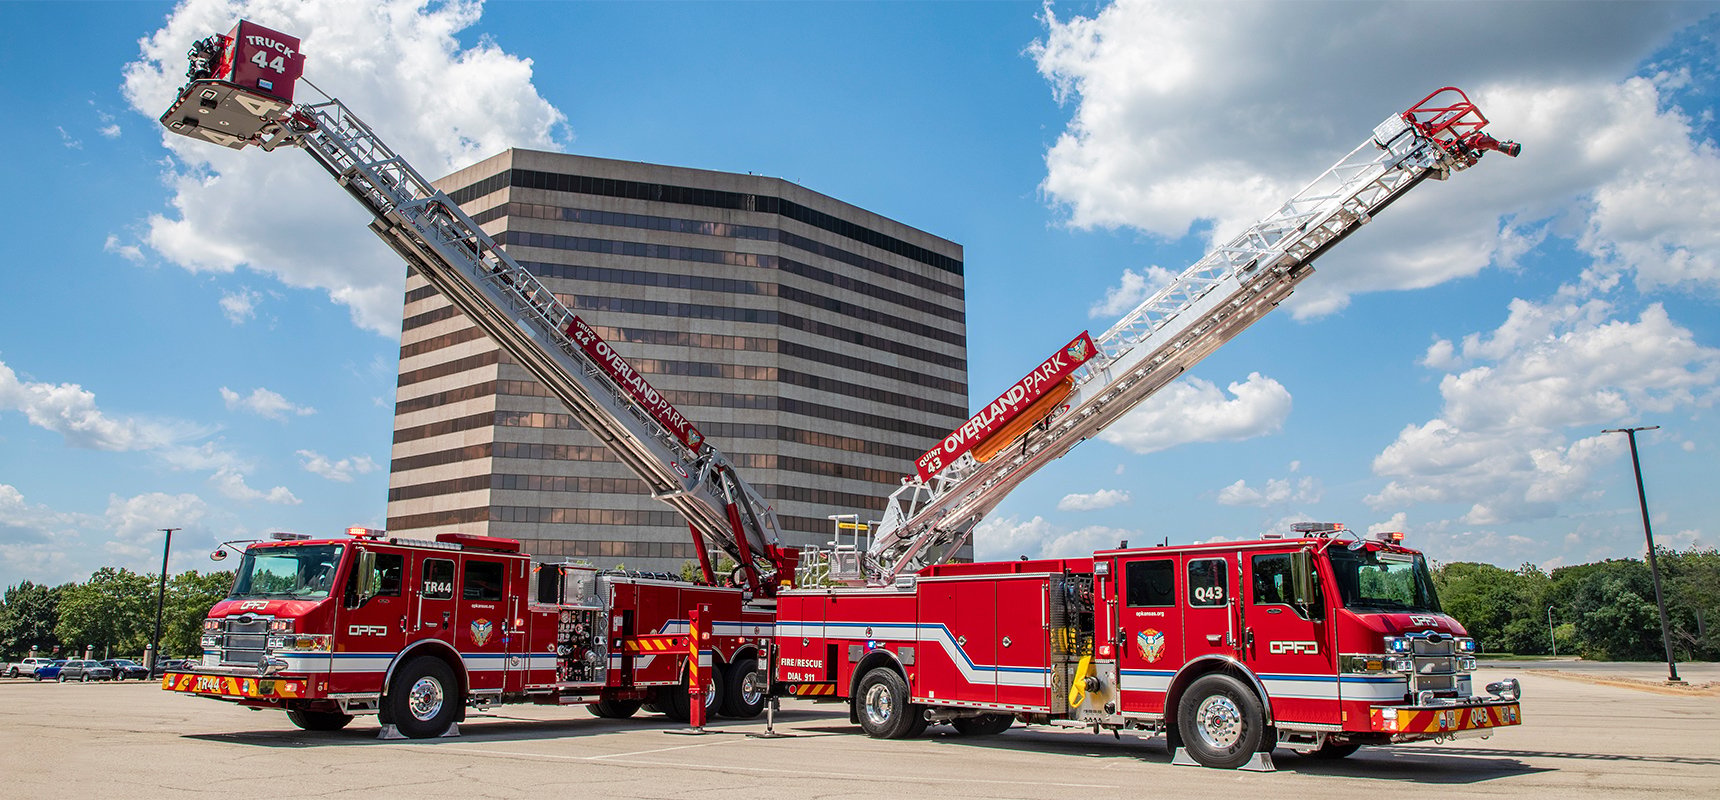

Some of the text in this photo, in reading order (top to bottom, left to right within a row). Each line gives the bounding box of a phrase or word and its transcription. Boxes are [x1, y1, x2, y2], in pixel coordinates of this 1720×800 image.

[246, 35, 295, 59] TRUCK
[251, 50, 286, 74] 44
[574, 331, 590, 347] 44
[576, 320, 597, 342] TRUCK
[596, 341, 689, 434] OVERLAND PARK
[613, 371, 663, 419] KANSAS
[944, 352, 1067, 454] OVERLAND PARK
[975, 388, 1041, 441] KANSAS
[919, 447, 942, 469] QUINT
[926, 459, 943, 474] 43
[424, 581, 452, 595] TR44
[1194, 586, 1223, 601] Q43
[780, 657, 823, 669] FIRE/RESCUE
[196, 676, 220, 692] TR44
[787, 672, 815, 682] DIAL 911
[1470, 707, 1488, 727] Q43
